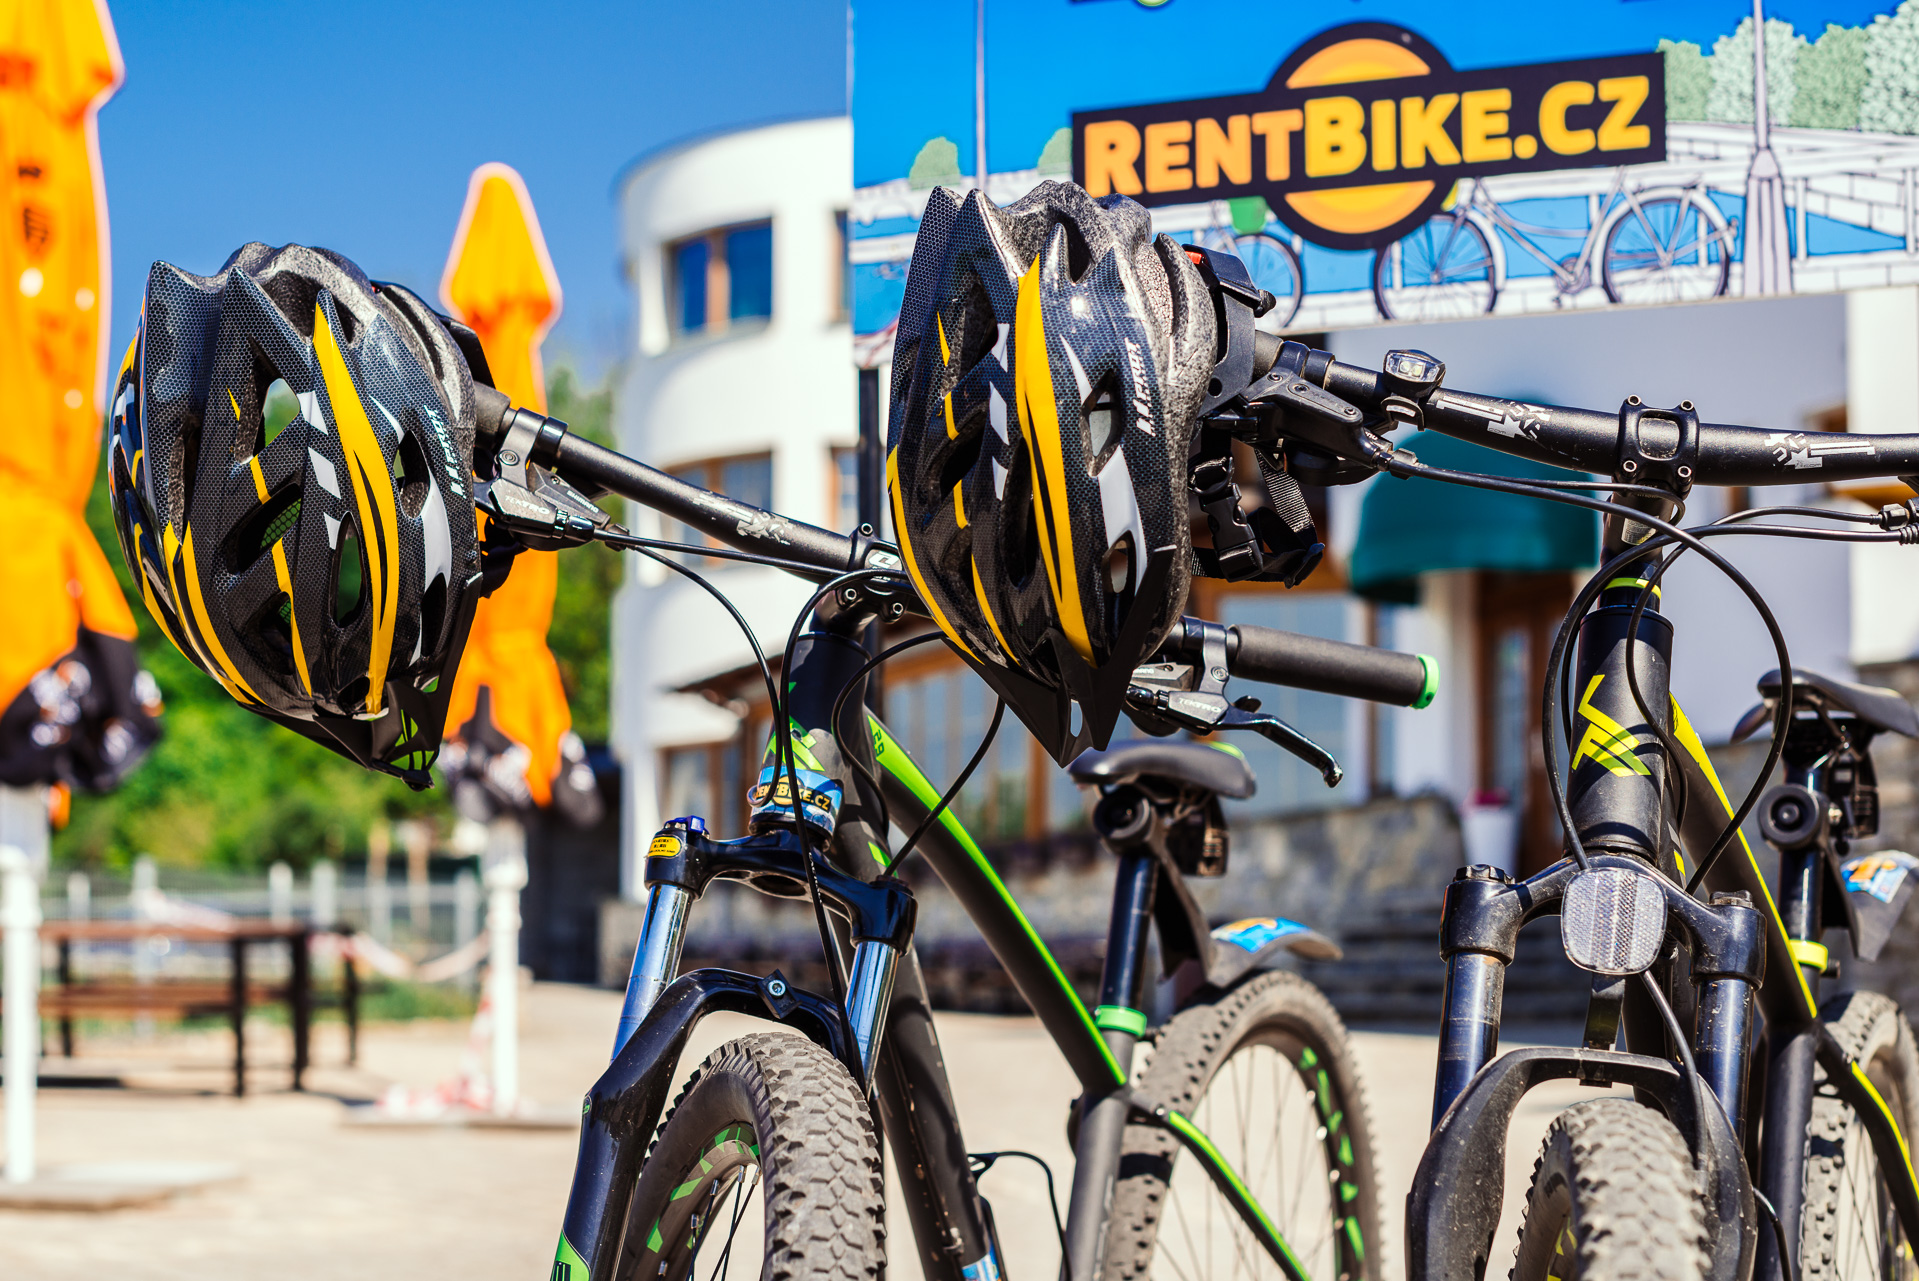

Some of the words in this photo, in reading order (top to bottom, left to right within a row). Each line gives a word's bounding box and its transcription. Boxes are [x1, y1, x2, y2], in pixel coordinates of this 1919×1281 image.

[1083, 74, 1651, 198] RENTBIKE.CZ
[505, 495, 551, 515] TEKTRO
[566, 490, 600, 514] SHIMANO
[1179, 697, 1222, 713] TEKTRO
